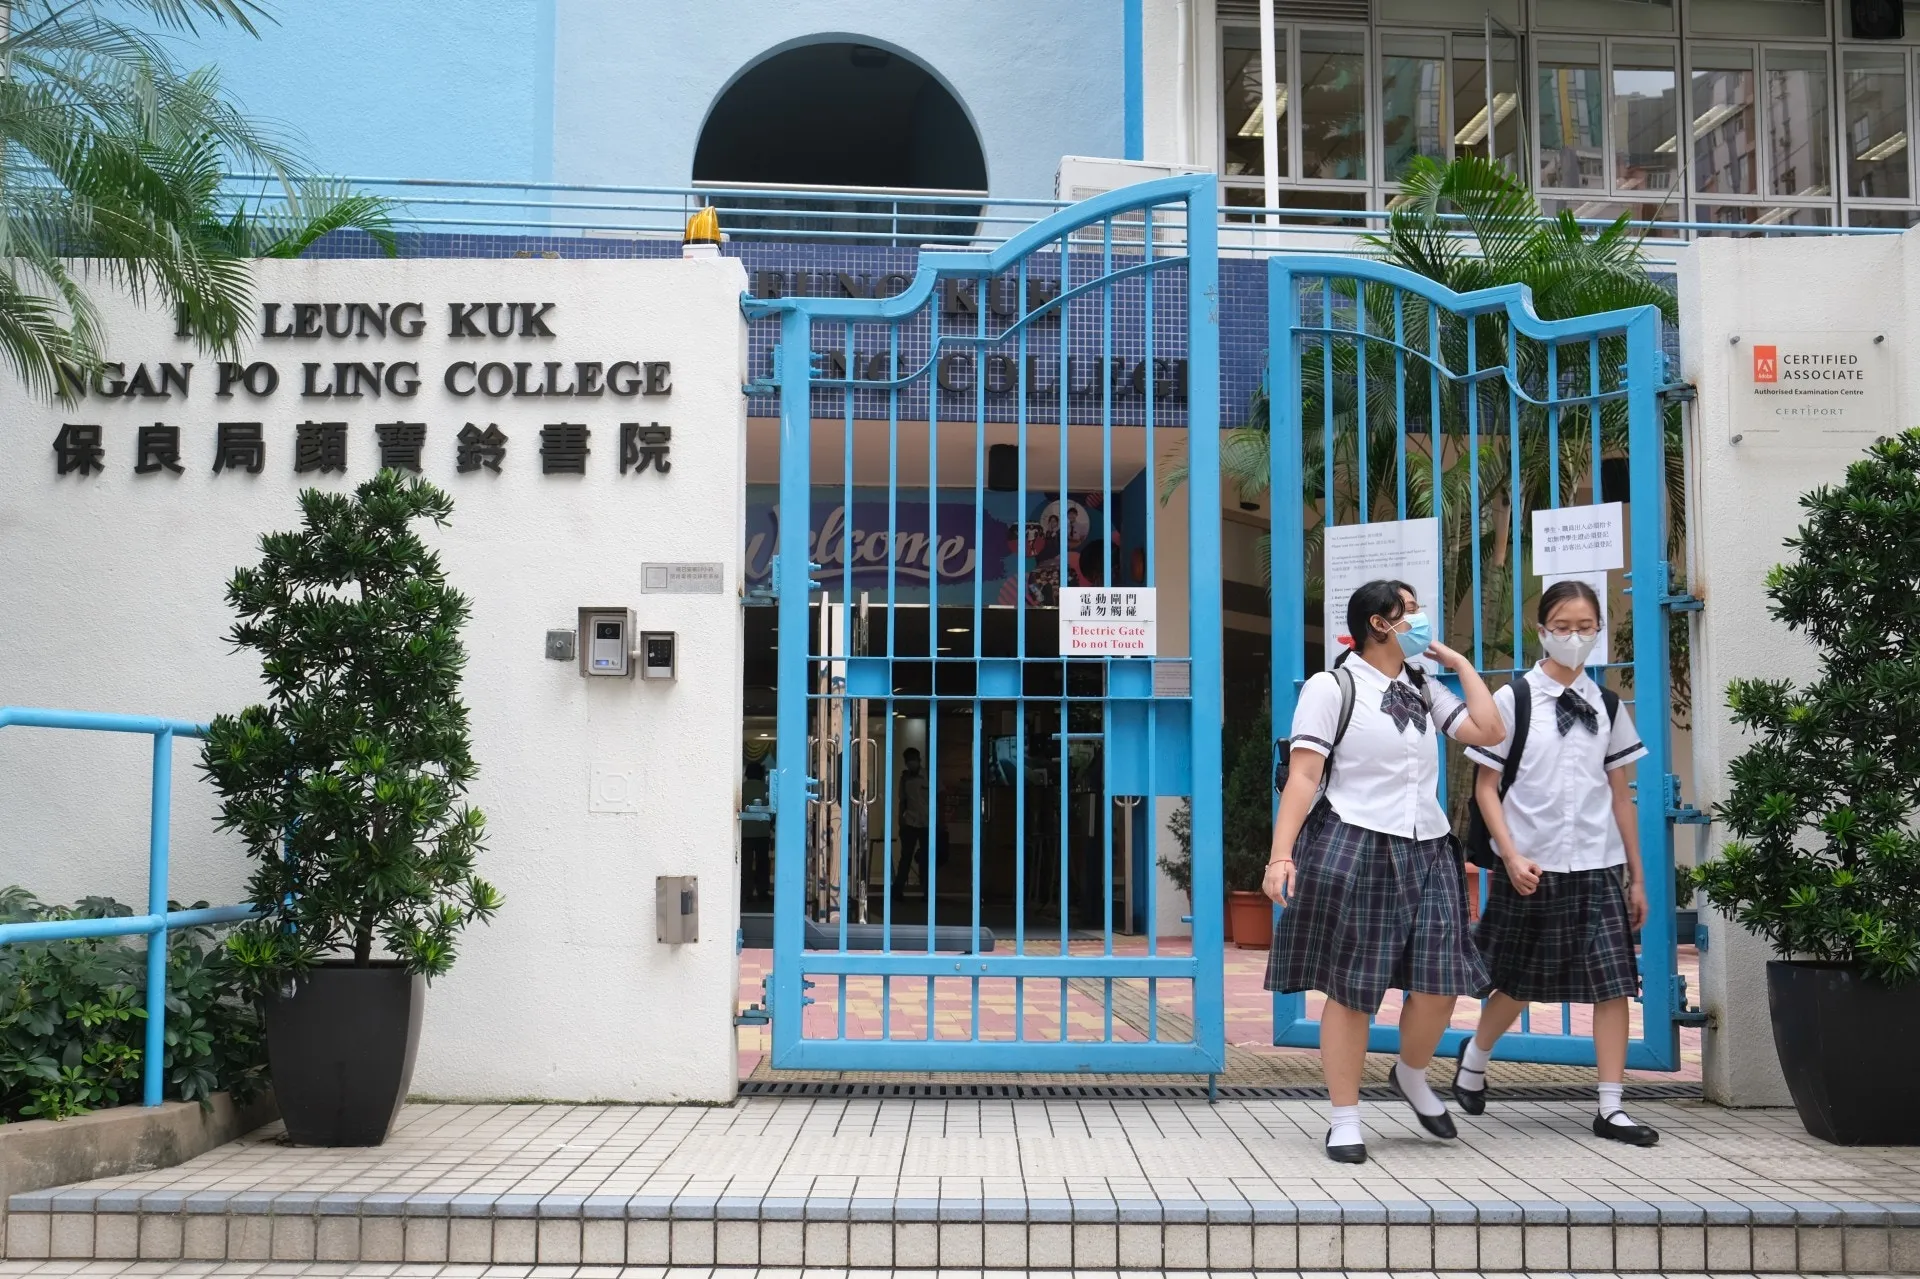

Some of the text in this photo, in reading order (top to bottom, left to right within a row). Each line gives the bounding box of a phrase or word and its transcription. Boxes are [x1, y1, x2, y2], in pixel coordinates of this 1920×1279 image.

[262, 303, 425, 338] LEUNG
[447, 302, 557, 338] KUK
[1783, 354, 1858, 365] CERTIFIED
[53, 361, 674, 399] NGAN PO LING COLLEGE
[1783, 370, 1864, 380] ASSOCIATE
[745, 503, 976, 579] Wlcome
[1080, 593, 1137, 605] 電動閘門
[1080, 605, 1137, 617] 請勿觸碰
[1072, 626, 1145, 636] Electric Gate
[1072, 639, 1145, 649] Do not Touch
